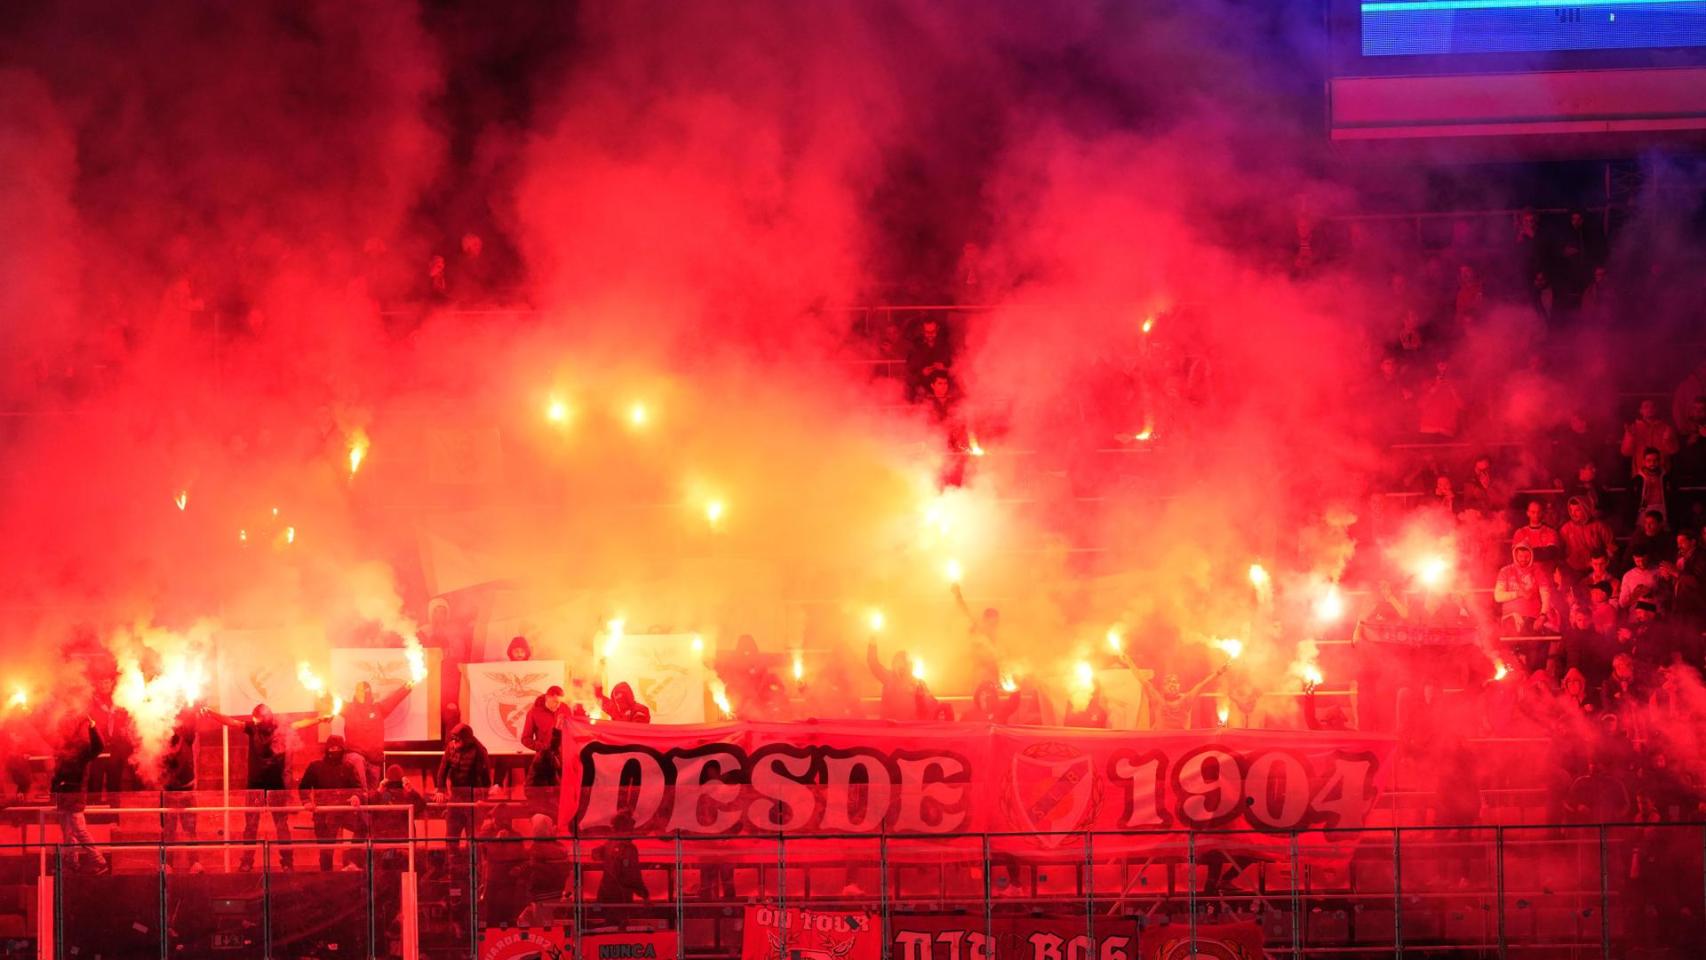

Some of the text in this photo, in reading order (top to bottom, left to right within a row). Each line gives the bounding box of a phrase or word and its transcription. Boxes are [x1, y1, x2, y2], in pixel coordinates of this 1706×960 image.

[571, 743, 1378, 841] DESDE 1904
[756, 908, 793, 928] ON
[599, 943, 657, 959] NUNCA
